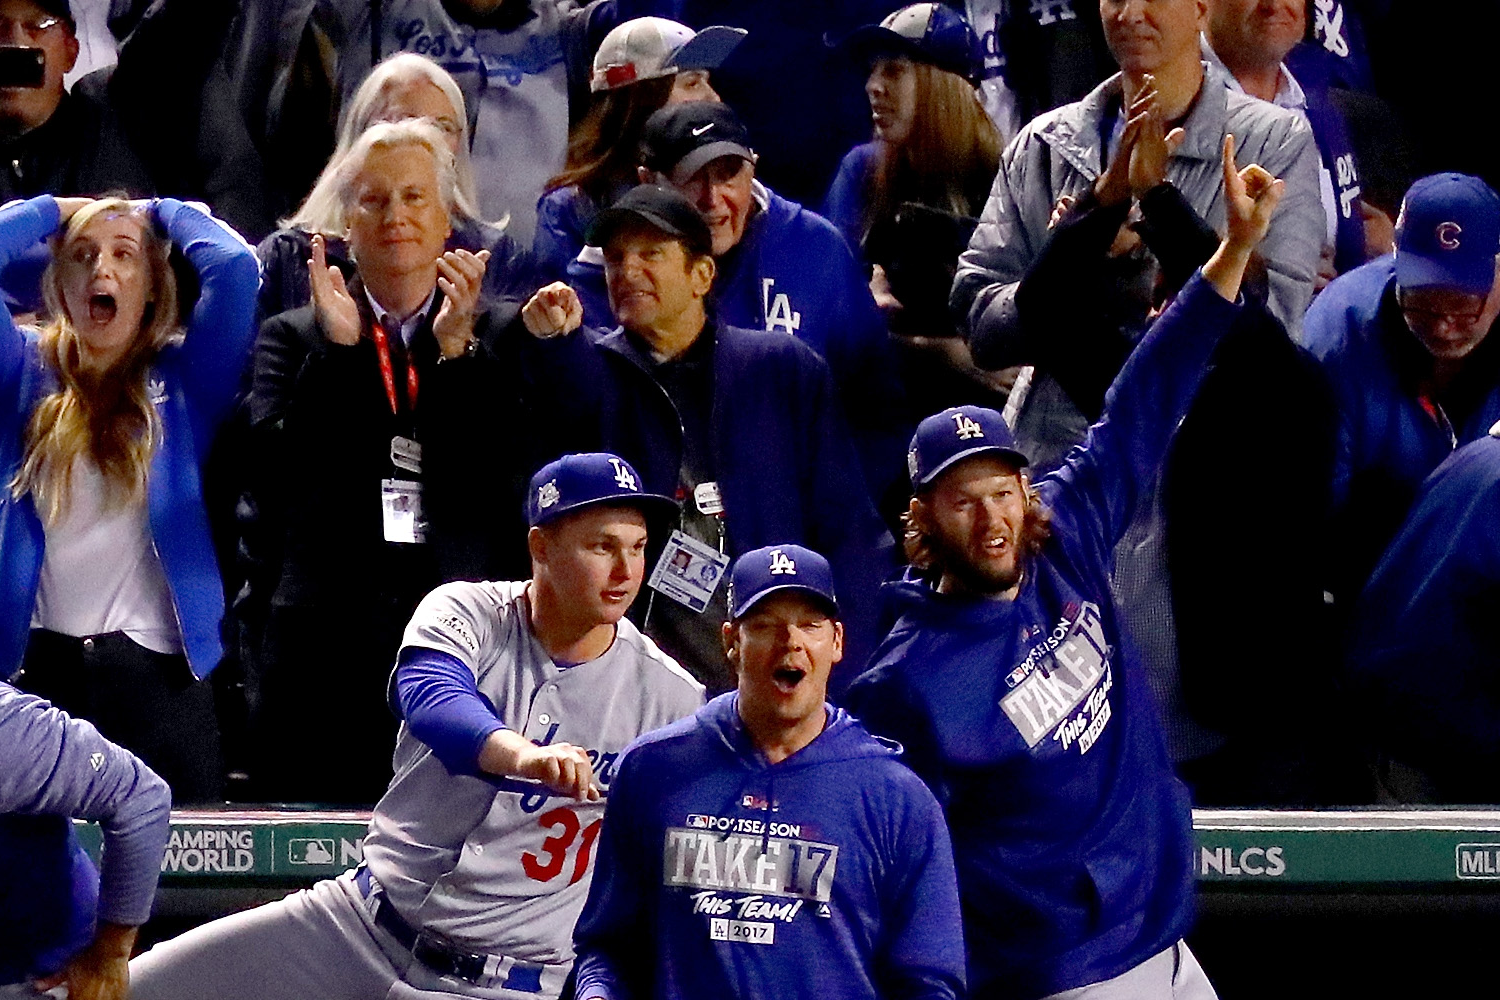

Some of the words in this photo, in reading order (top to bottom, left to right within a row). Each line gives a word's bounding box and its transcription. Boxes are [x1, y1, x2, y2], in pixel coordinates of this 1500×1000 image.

[1435, 221, 1462, 250] C
[951, 412, 985, 440] LA
[607, 458, 638, 491] LA
[769, 549, 797, 575] LA
[165, 829, 254, 850] AMPING
[521, 806, 602, 887] 31
[1202, 846, 1286, 876] NLCS
[690, 891, 732, 915] THIS
[733, 924, 768, 938] 2017
